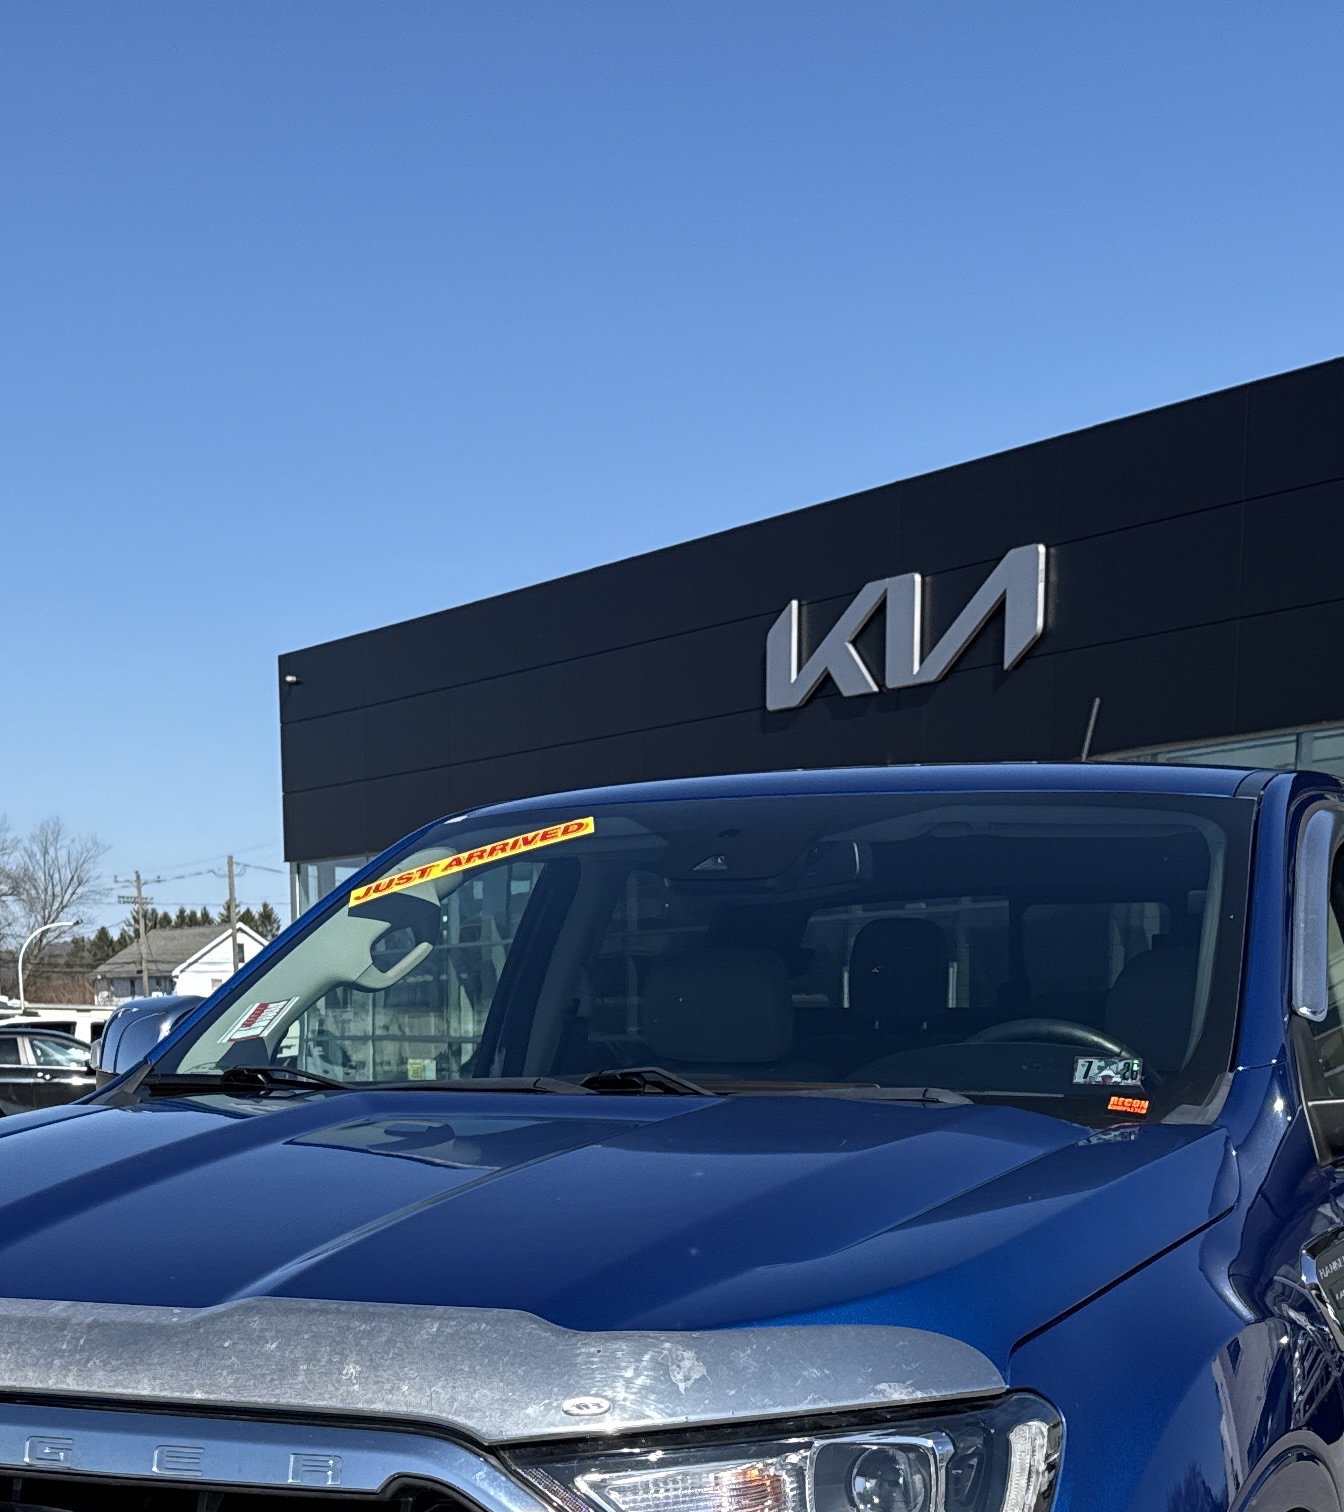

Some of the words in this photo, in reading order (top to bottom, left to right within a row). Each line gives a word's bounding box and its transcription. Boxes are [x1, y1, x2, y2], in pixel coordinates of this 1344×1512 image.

[765, 542, 1046, 712] KIA
[353, 863, 440, 902] JUST
[440, 821, 590, 873] ARRIVED
[1083, 1060, 1094, 1080] 7
